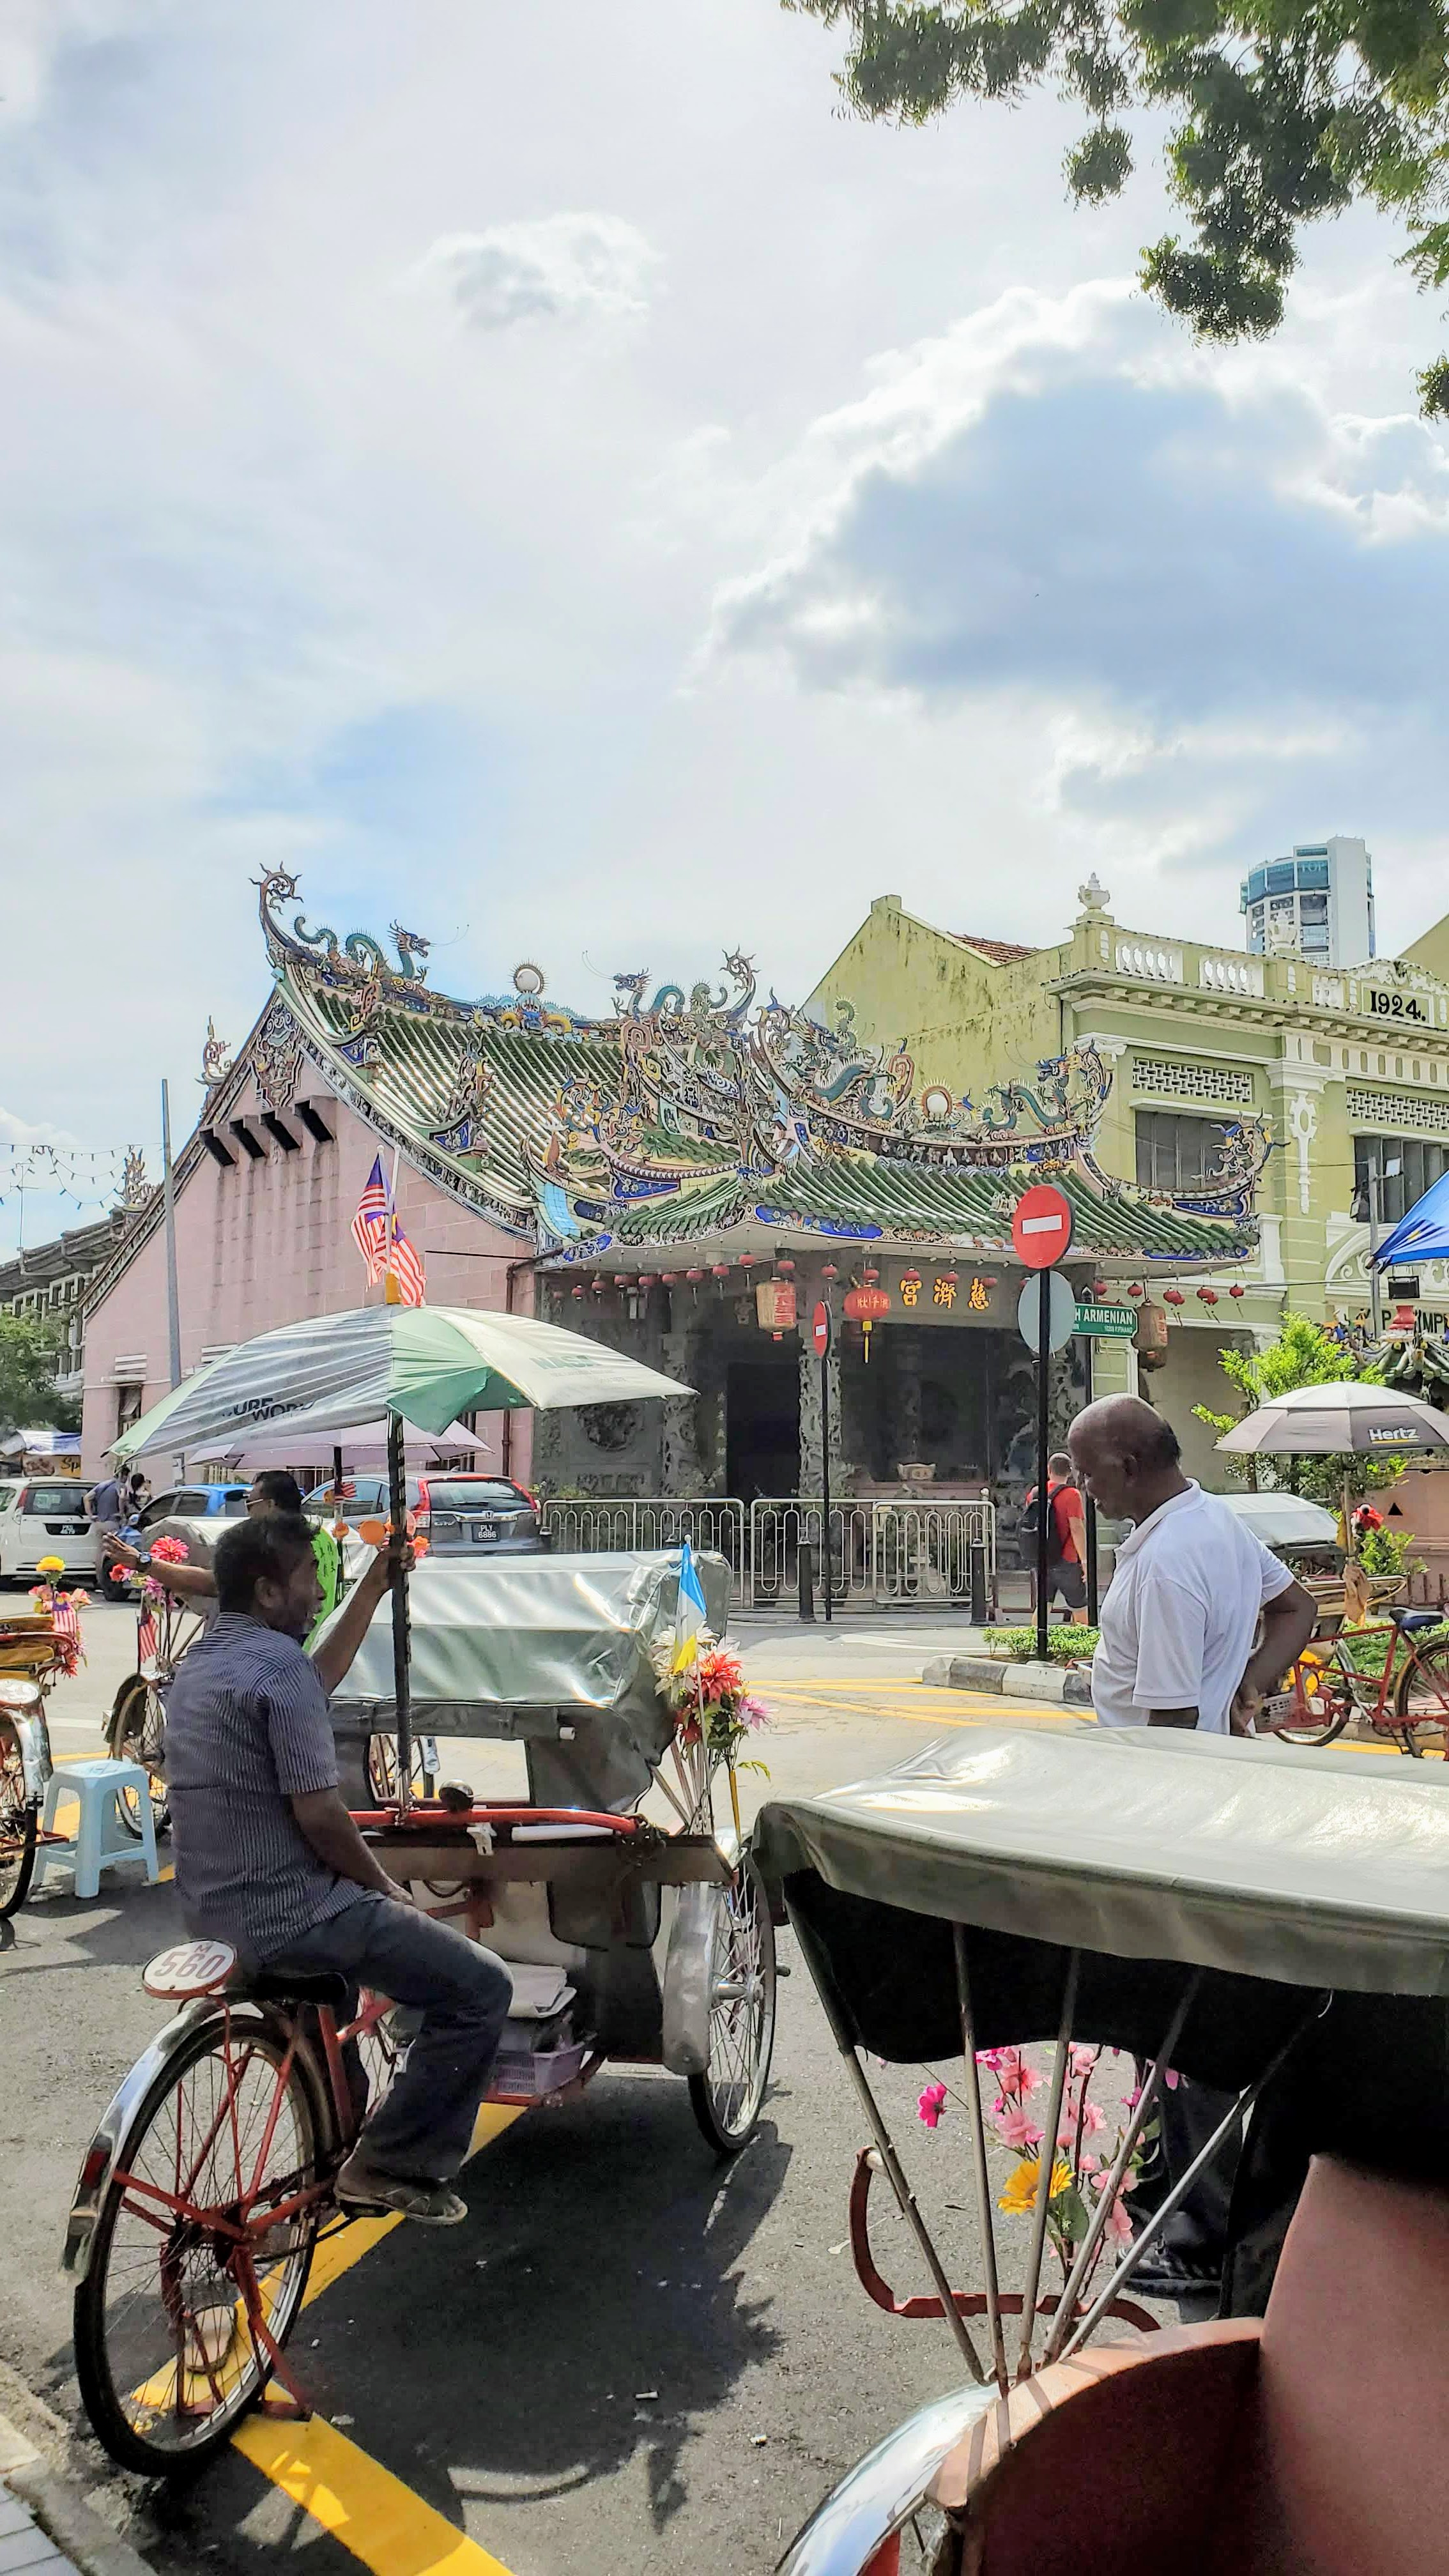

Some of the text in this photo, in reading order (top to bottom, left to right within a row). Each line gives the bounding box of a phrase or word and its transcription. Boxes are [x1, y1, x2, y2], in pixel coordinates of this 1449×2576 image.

[1083, 1308, 1133, 1325] ARMENIAN
[1368, 1427, 1420, 1441] Hertz
[194, 1944, 214, 1953] M
[153, 1951, 227, 1979] 560
